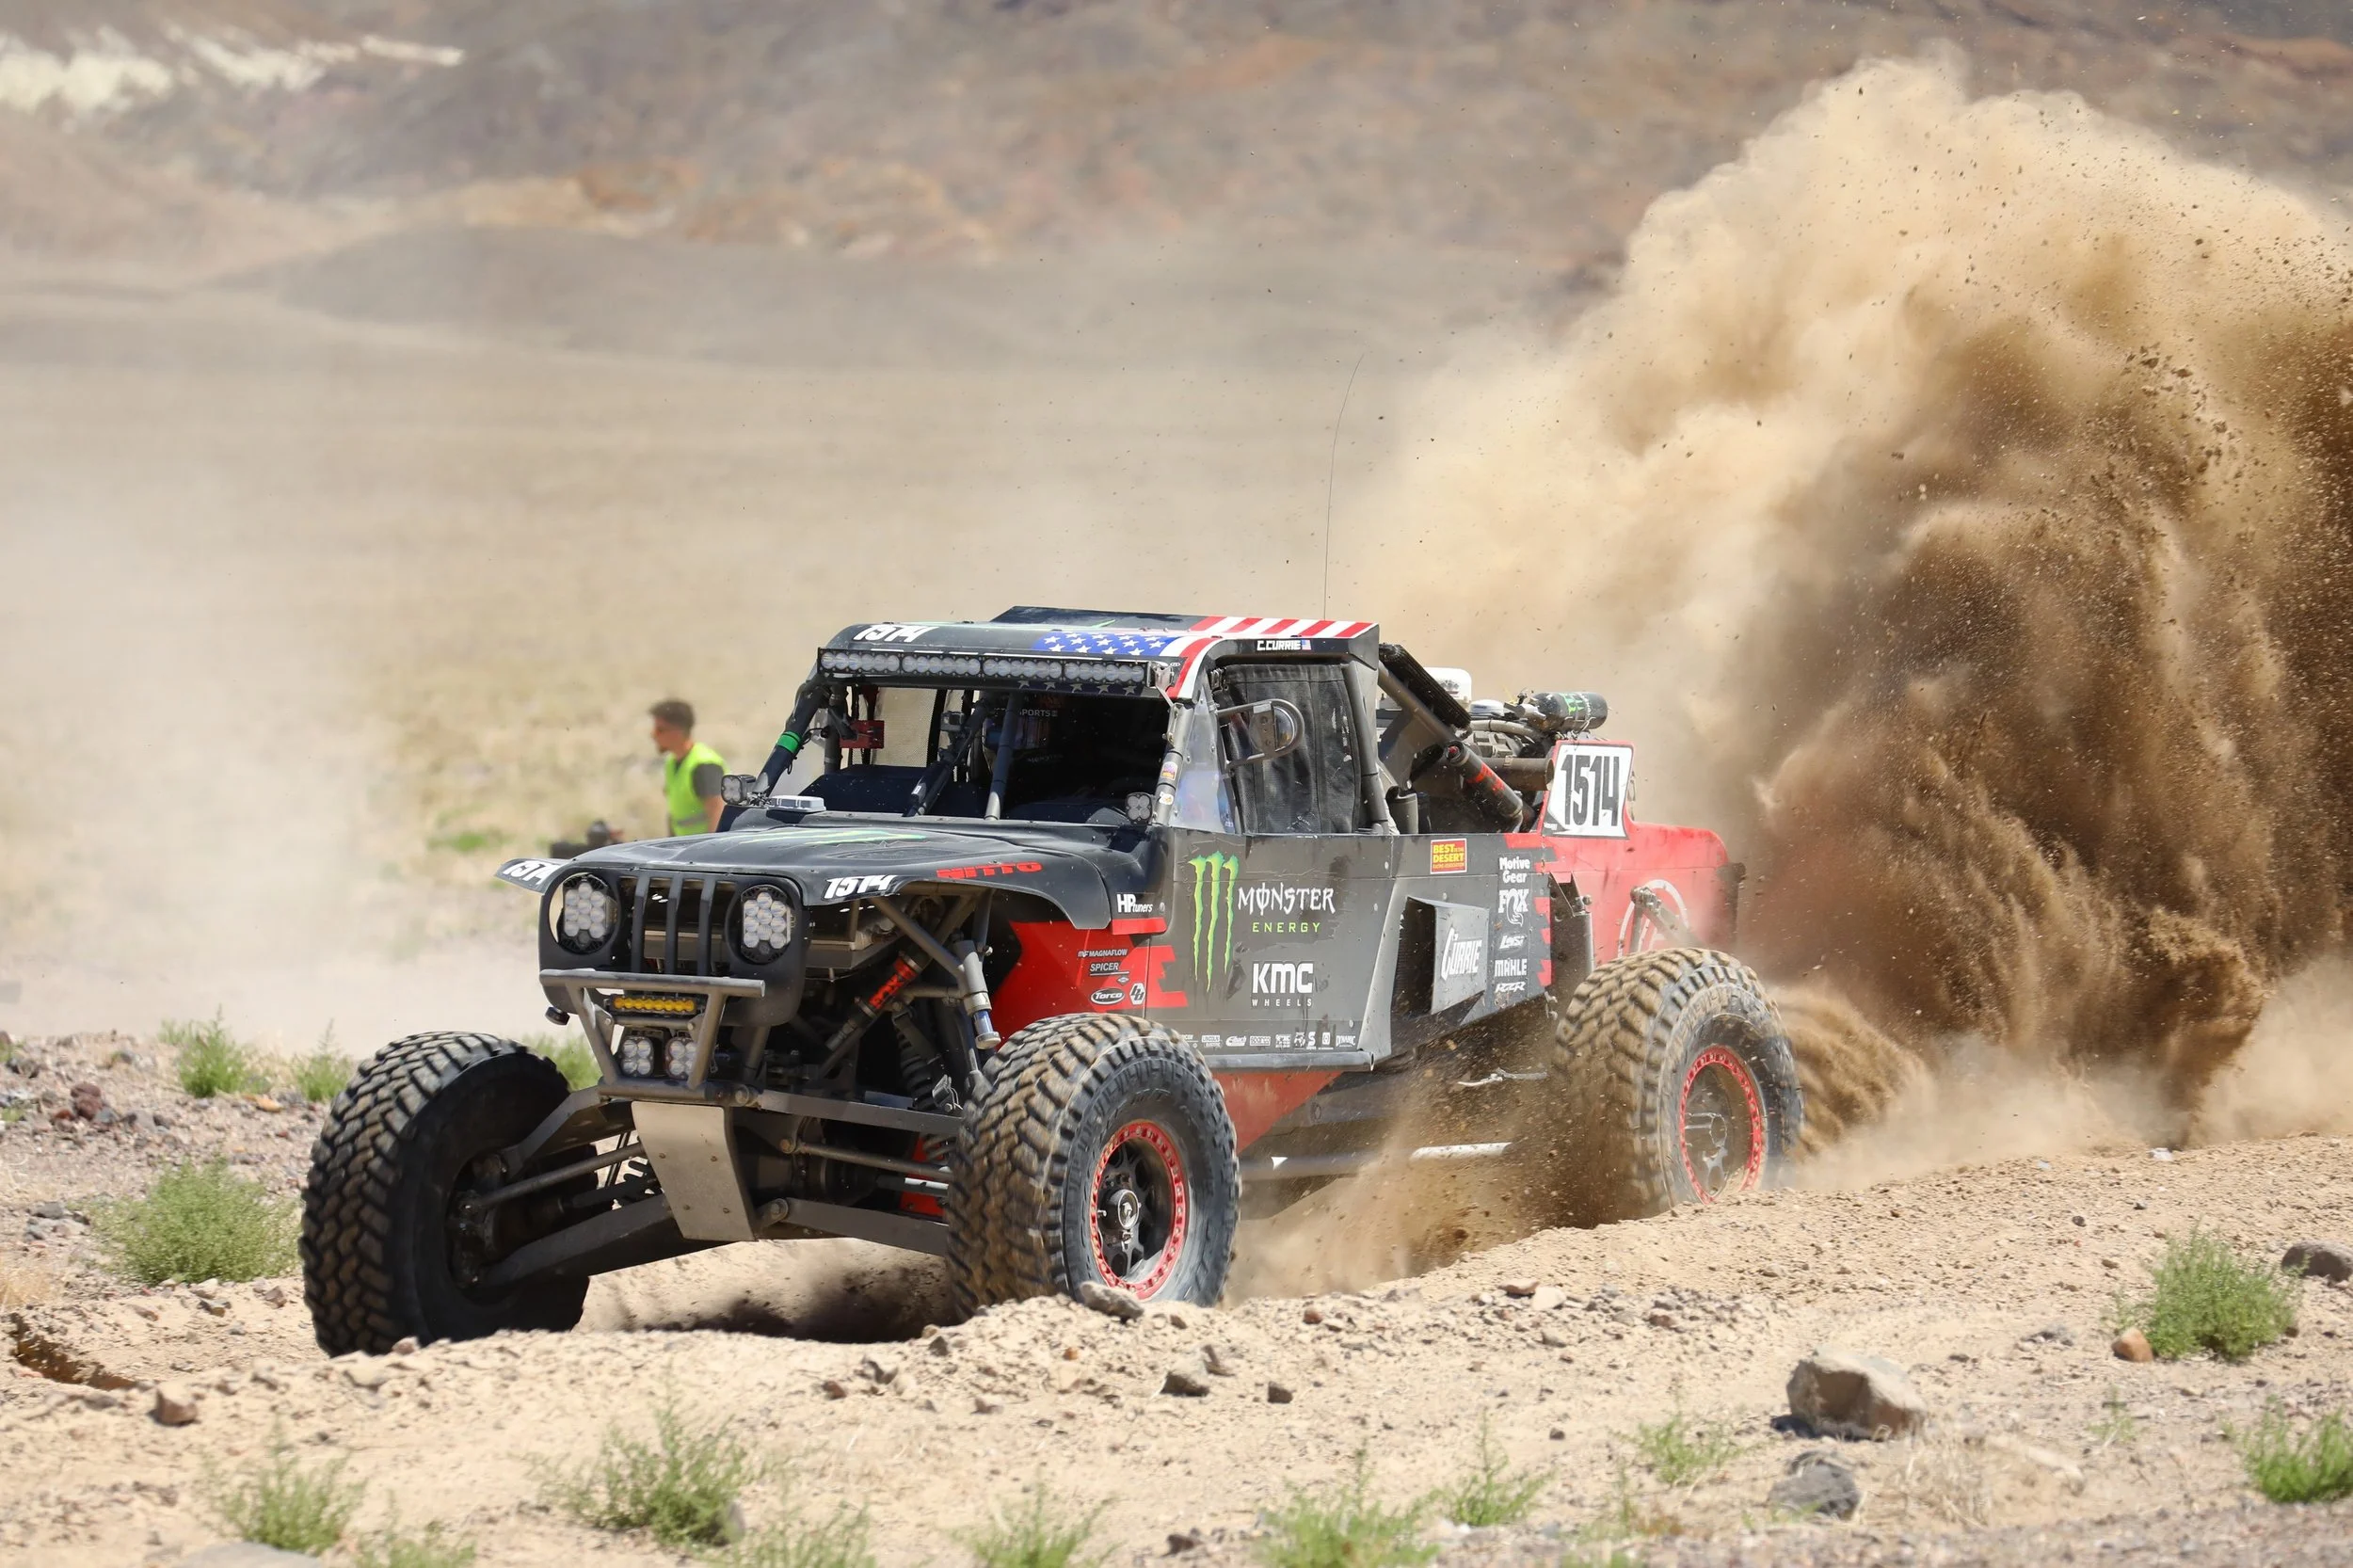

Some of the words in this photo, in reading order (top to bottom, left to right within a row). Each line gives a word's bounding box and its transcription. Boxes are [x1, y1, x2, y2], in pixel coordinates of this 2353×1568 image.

[854, 625, 939, 643] 1514
[1019, 709, 1051, 717] PORTS
[1561, 755, 1620, 827] 1514
[1433, 843, 1455, 854] BEST
[1433, 853, 1465, 863] DESERT
[1499, 856, 1530, 871] Motive
[936, 861, 1043, 880] NITTO
[1502, 871, 1528, 884] Gear
[824, 875, 899, 899] 1514
[1497, 888, 1529, 922] FOX
[1252, 922, 1321, 933] ENERGY
[1089, 949, 1128, 957] MAGNAFLOW
[1090, 962, 1119, 972] SPICER
[1495, 958, 1528, 977] MAHLE
[1252, 963, 1314, 994] KMC
[1095, 991, 1123, 1001] Torco
[1252, 999, 1312, 1007] WHEELS
